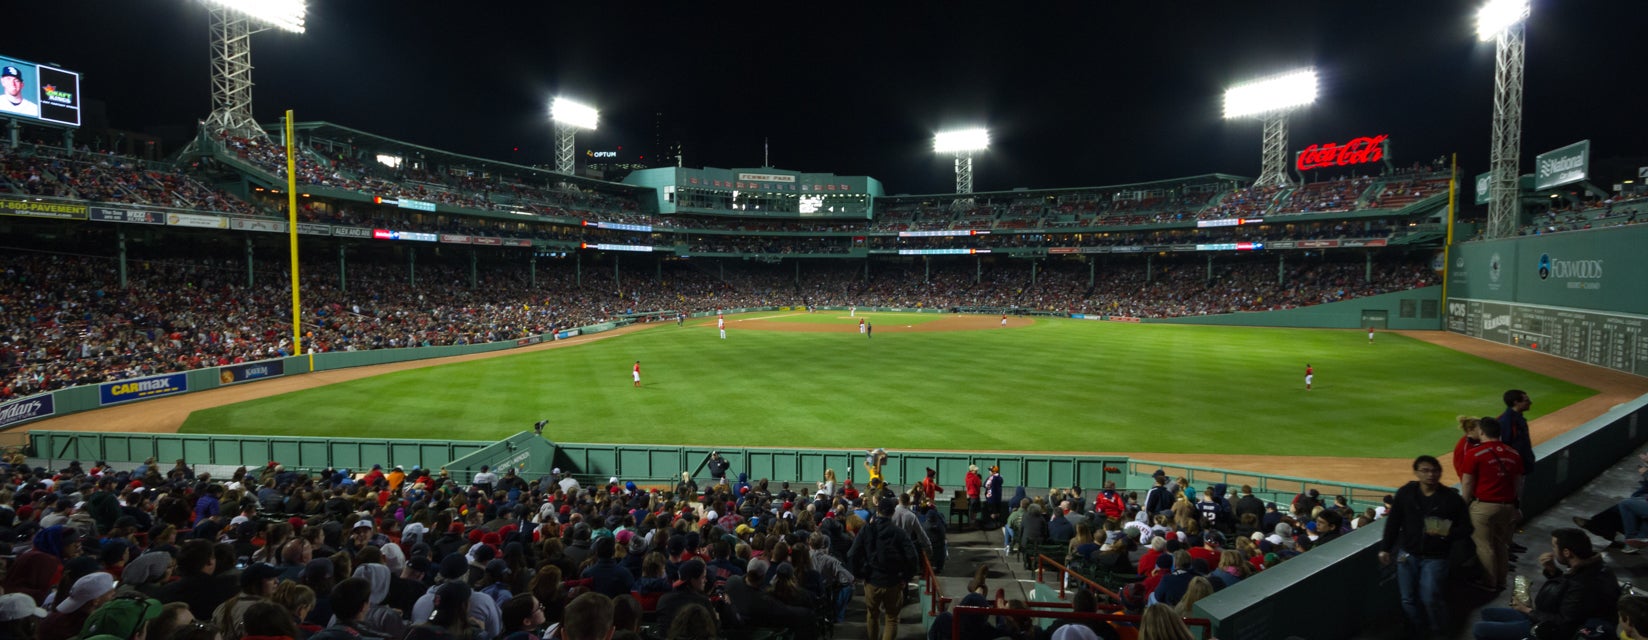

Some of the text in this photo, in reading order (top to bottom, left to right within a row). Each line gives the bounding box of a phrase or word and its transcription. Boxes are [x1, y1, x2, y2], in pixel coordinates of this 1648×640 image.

[1550, 150, 1584, 173] National
[0, 202, 86, 214] 1-800-PAVEMENT
[1454, 303, 1466, 317] CVS
[0, 400, 41, 420] ordan's
[0, 411, 37, 424] URNITURE
